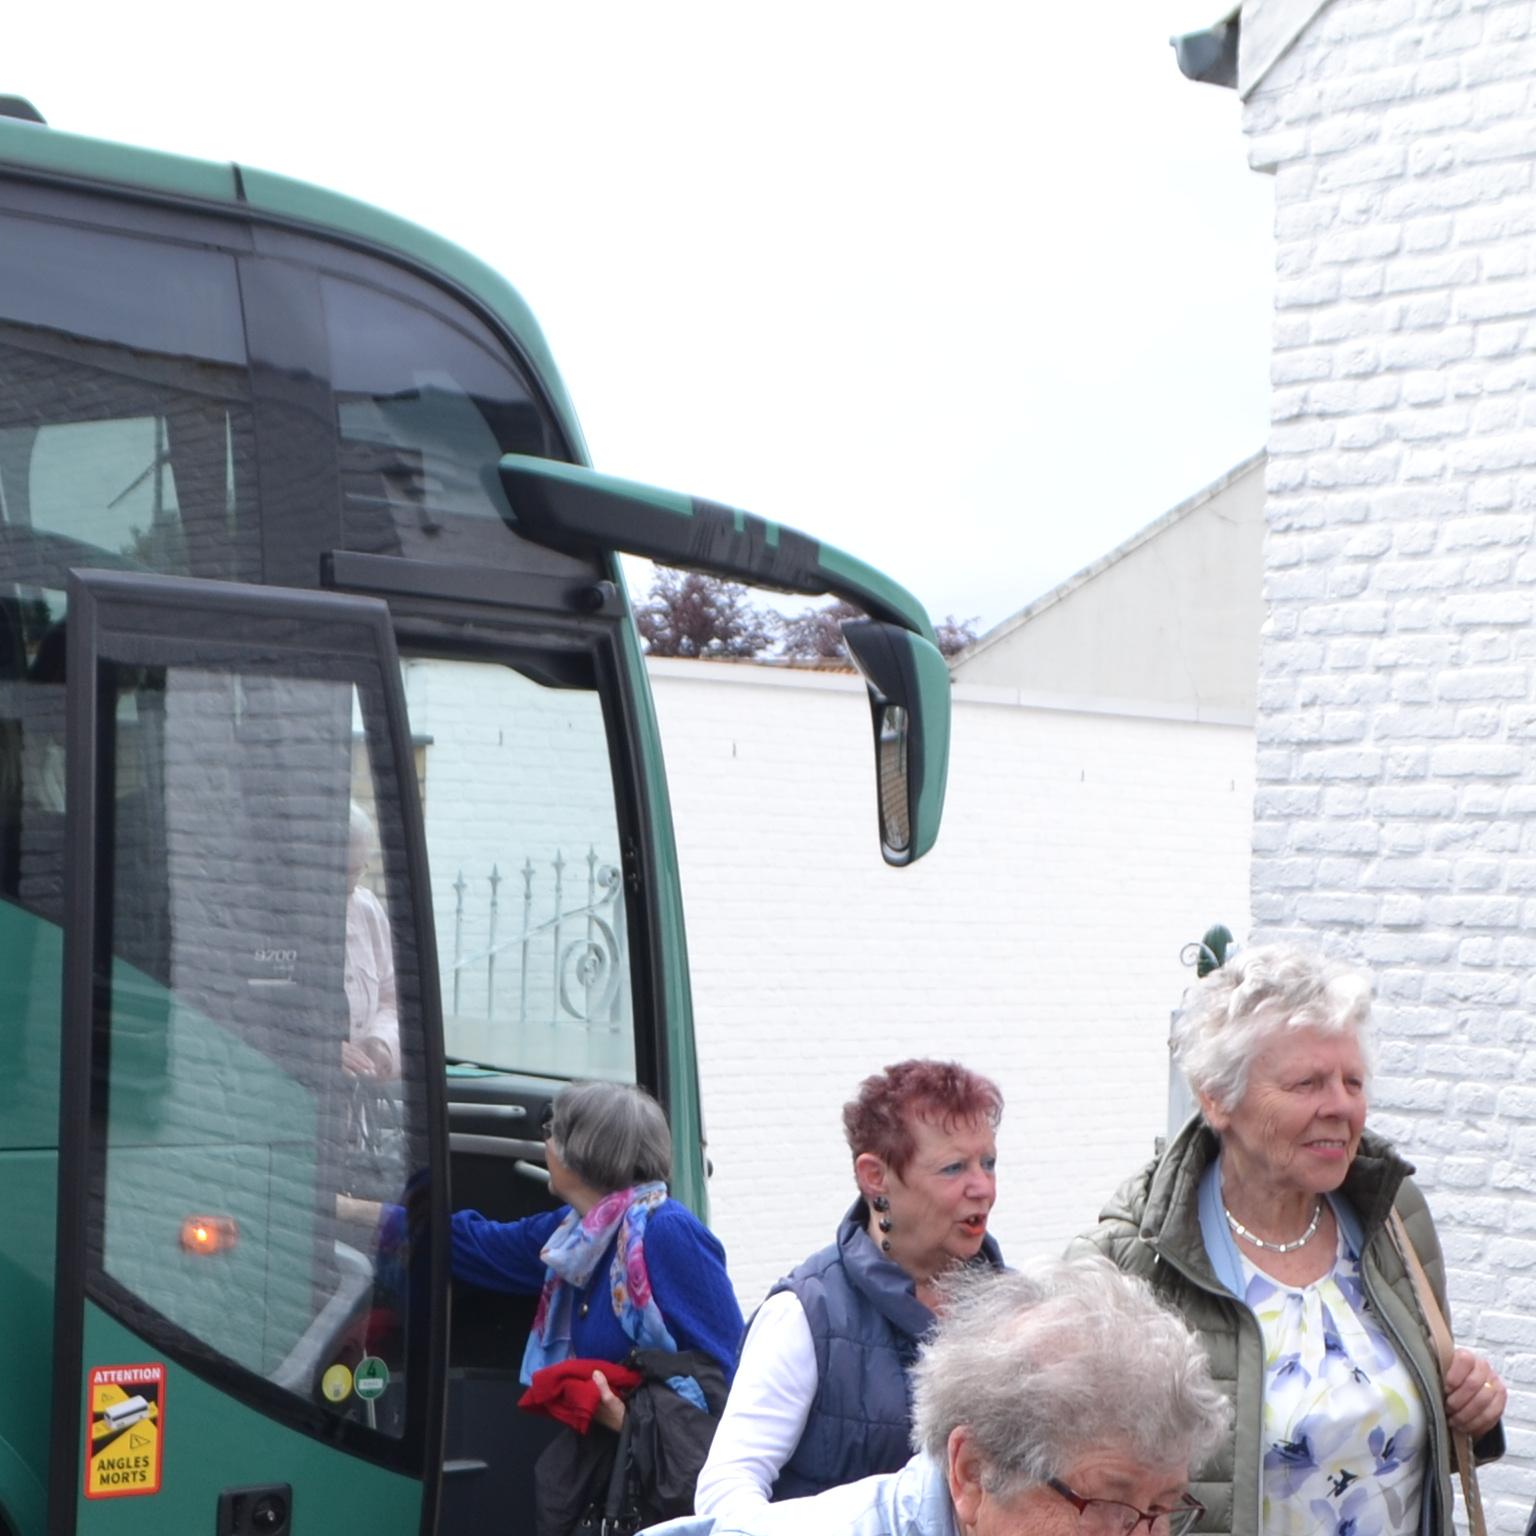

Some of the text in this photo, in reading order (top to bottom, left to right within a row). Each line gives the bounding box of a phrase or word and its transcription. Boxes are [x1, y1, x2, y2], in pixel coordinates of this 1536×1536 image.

[94, 1367, 161, 1383] ATTENTION
[367, 1361, 376, 1377] 4
[97, 1456, 150, 1472] ANGLES
[99, 1470, 147, 1486] MORTS
